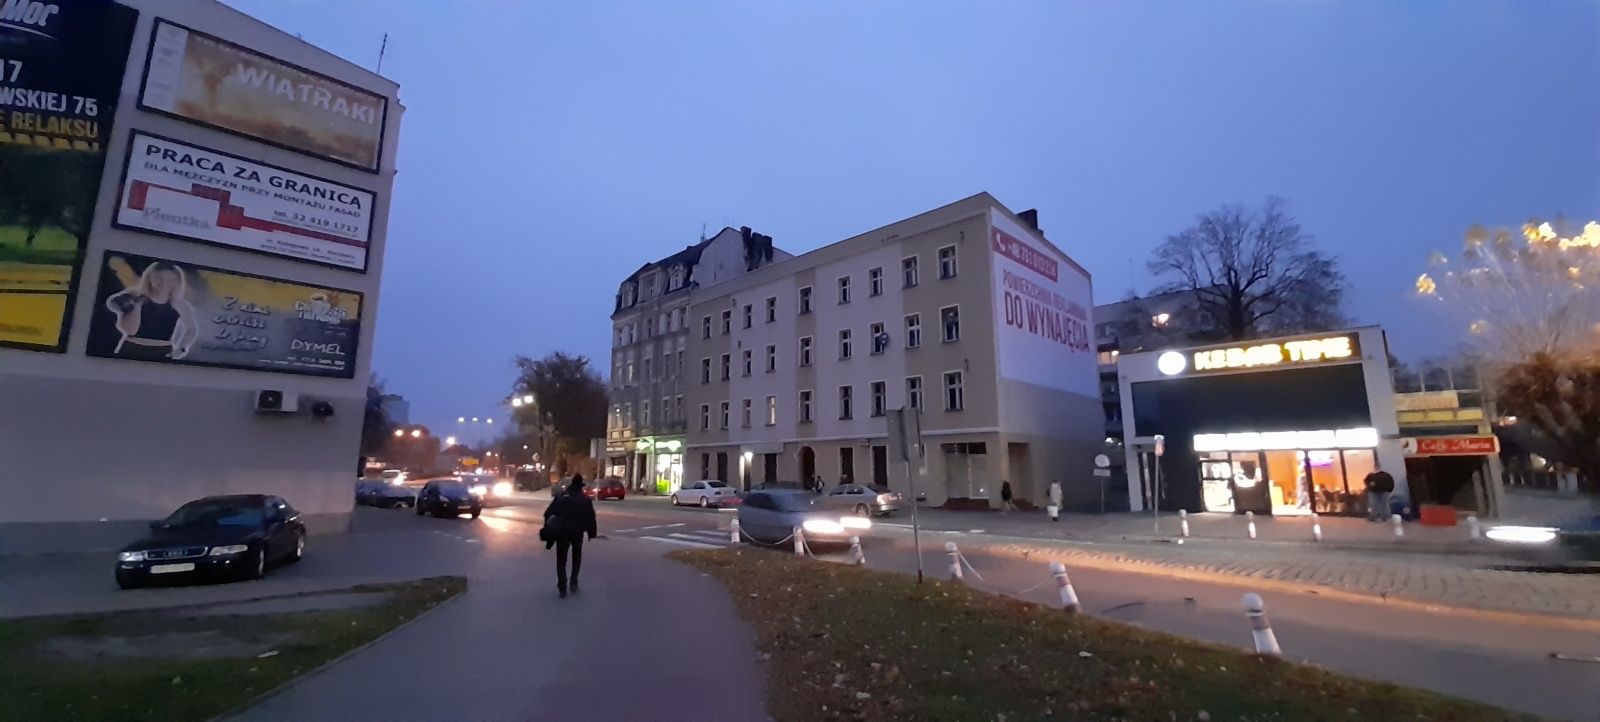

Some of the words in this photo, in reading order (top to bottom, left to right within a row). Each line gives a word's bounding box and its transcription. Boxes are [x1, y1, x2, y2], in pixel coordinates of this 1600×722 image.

[73, 95, 98, 117] 75
[11, 110, 99, 138] RELAKSU
[144, 161, 169, 173] DLA
[241, 184, 270, 197] PRZY
[329, 205, 361, 218] FASAD
[145, 144, 226, 175] PRACA
[233, 166, 261, 183] ZA
[268, 175, 361, 210] GRANICA
[1004, 290, 1024, 330] DO
[1025, 298, 1090, 353] WYNAJĘCIA
[291, 338, 346, 356] DYMEL
[1194, 343, 1283, 371] KEBAB
[1284, 336, 1352, 361] TIME
[1452, 438, 1491, 451] Maria
